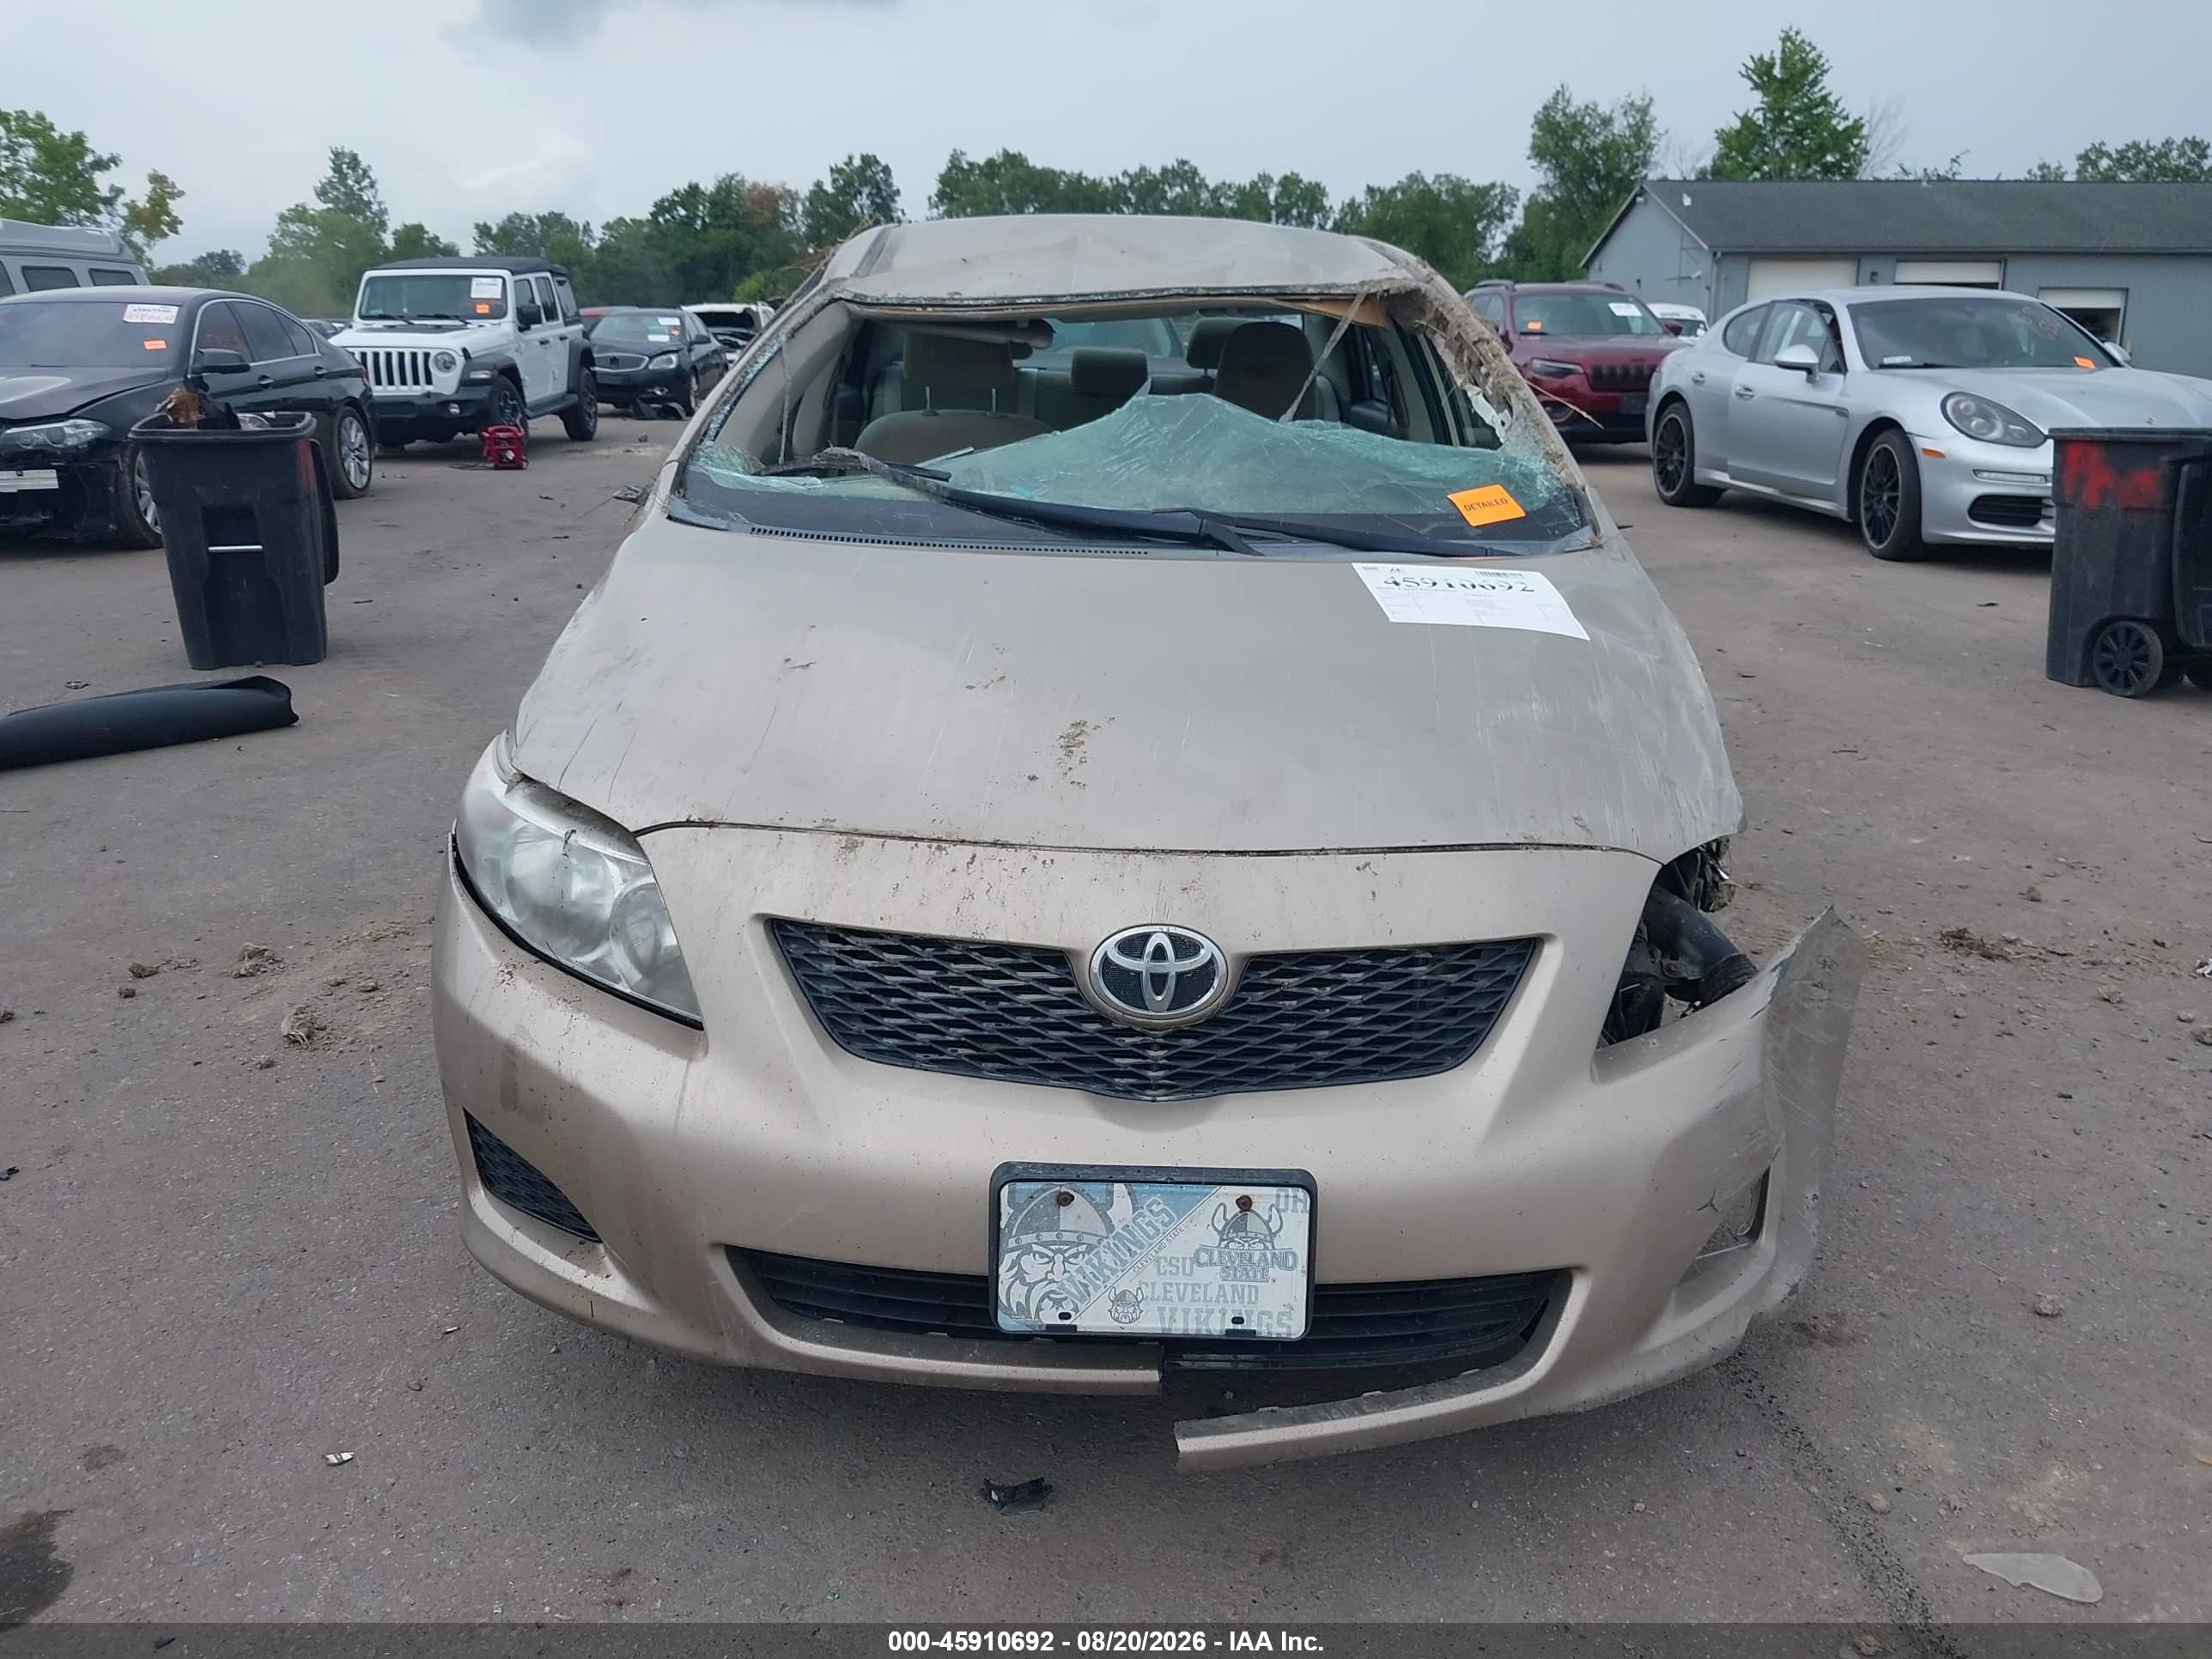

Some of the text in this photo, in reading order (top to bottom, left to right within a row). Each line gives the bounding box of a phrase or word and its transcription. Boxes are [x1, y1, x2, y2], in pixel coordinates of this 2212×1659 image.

[1463, 497, 1509, 512] DETAILED
[1383, 575, 1535, 593] 45910692
[1057, 1196, 1177, 1305] VIKINGS
[1133, 1226, 1185, 1273] CLEVELAND STATE
[1194, 1247, 1299, 1271] CLEVELAND
[1156, 1256, 1195, 1277] CSU
[1219, 1266, 1270, 1282] STATE
[1139, 1281, 1260, 1304] CLEVELAND
